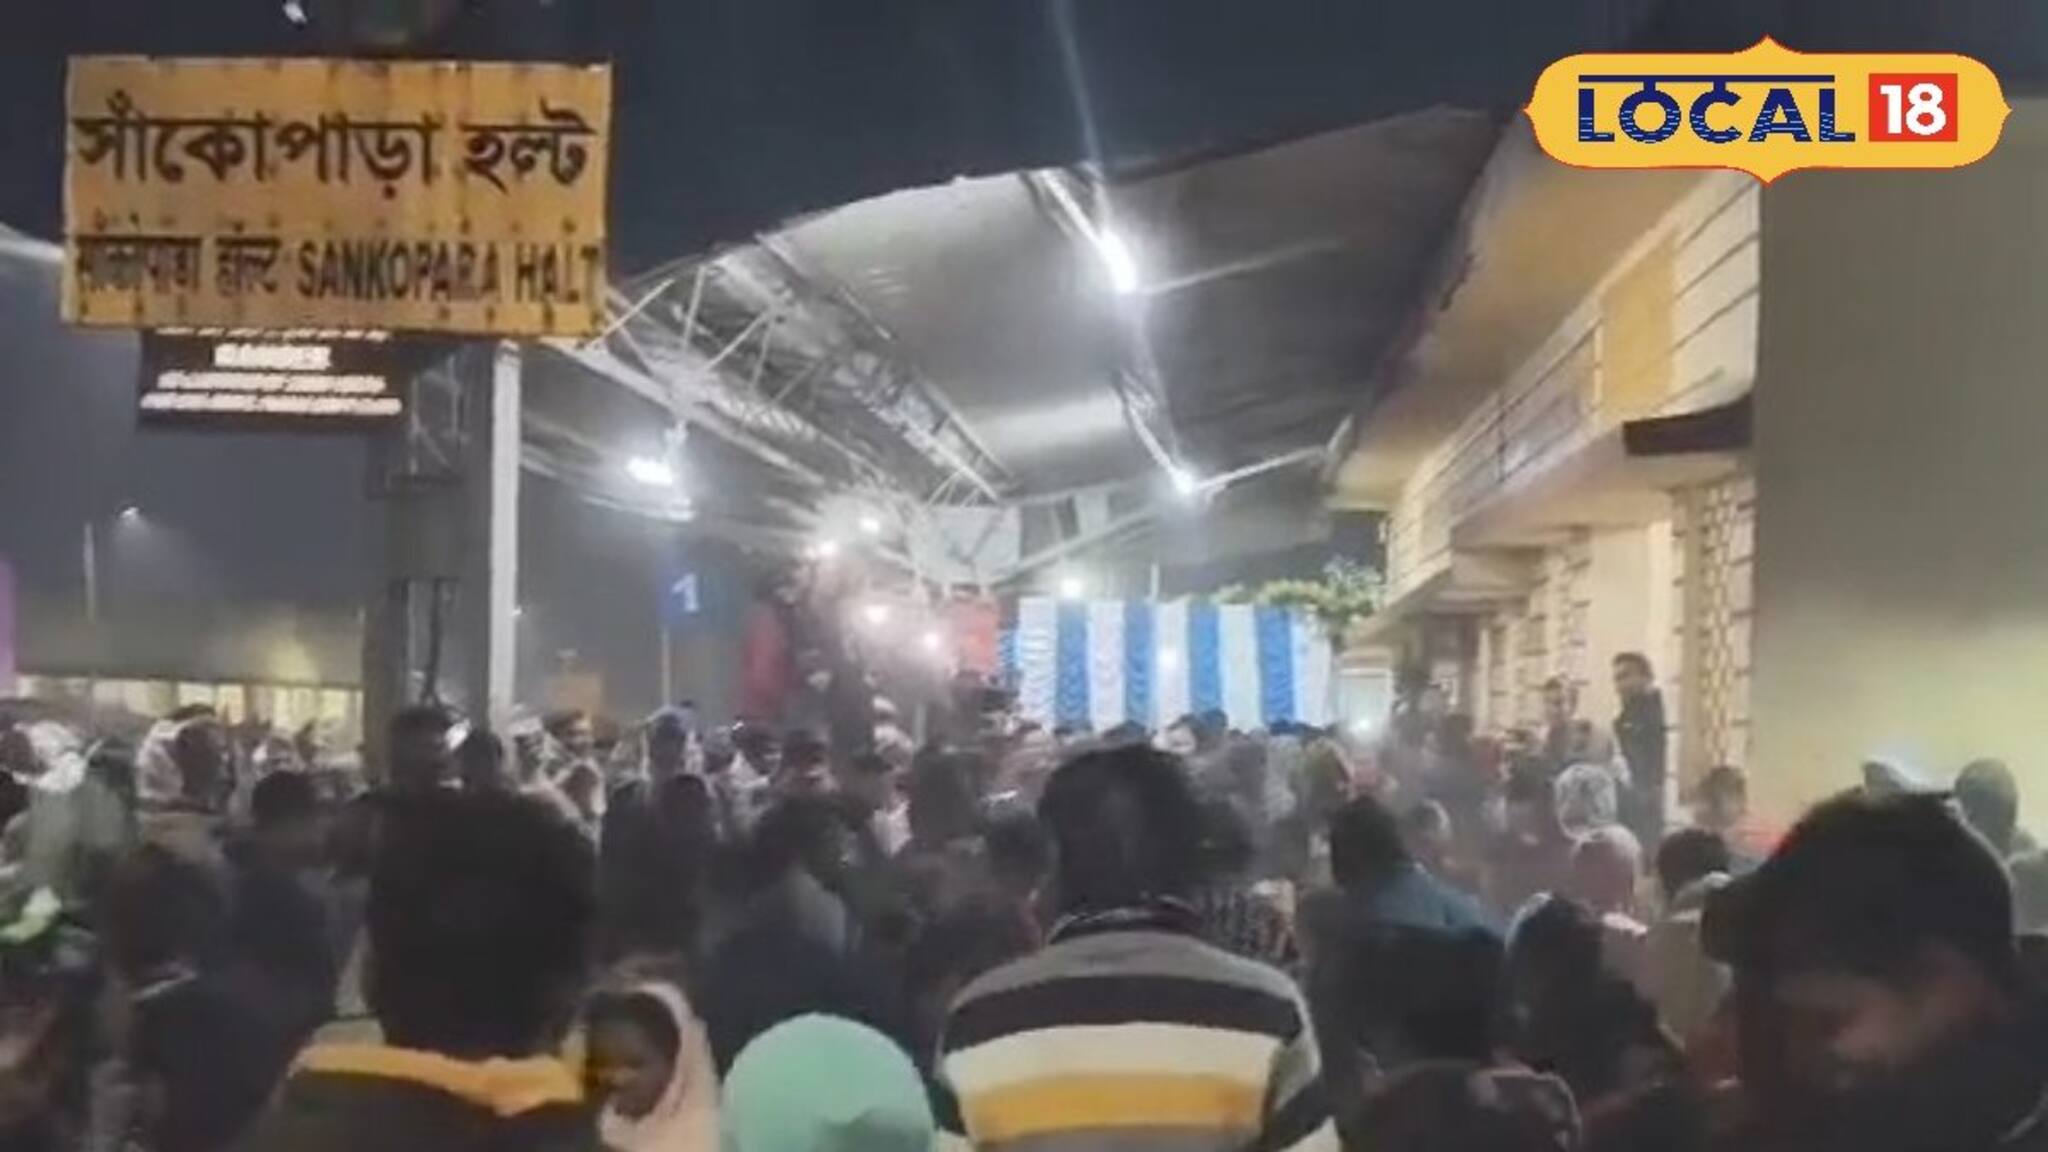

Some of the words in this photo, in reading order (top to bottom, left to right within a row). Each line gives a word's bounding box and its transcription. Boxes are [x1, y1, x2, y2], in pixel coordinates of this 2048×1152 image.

[73, 90, 441, 198] সাঁকোপাড়া
[461, 97, 598, 195] হল্ট
[298, 240, 500, 301] SANKOPARA
[514, 243, 600, 304] HALT
[671, 573, 700, 612] 1
